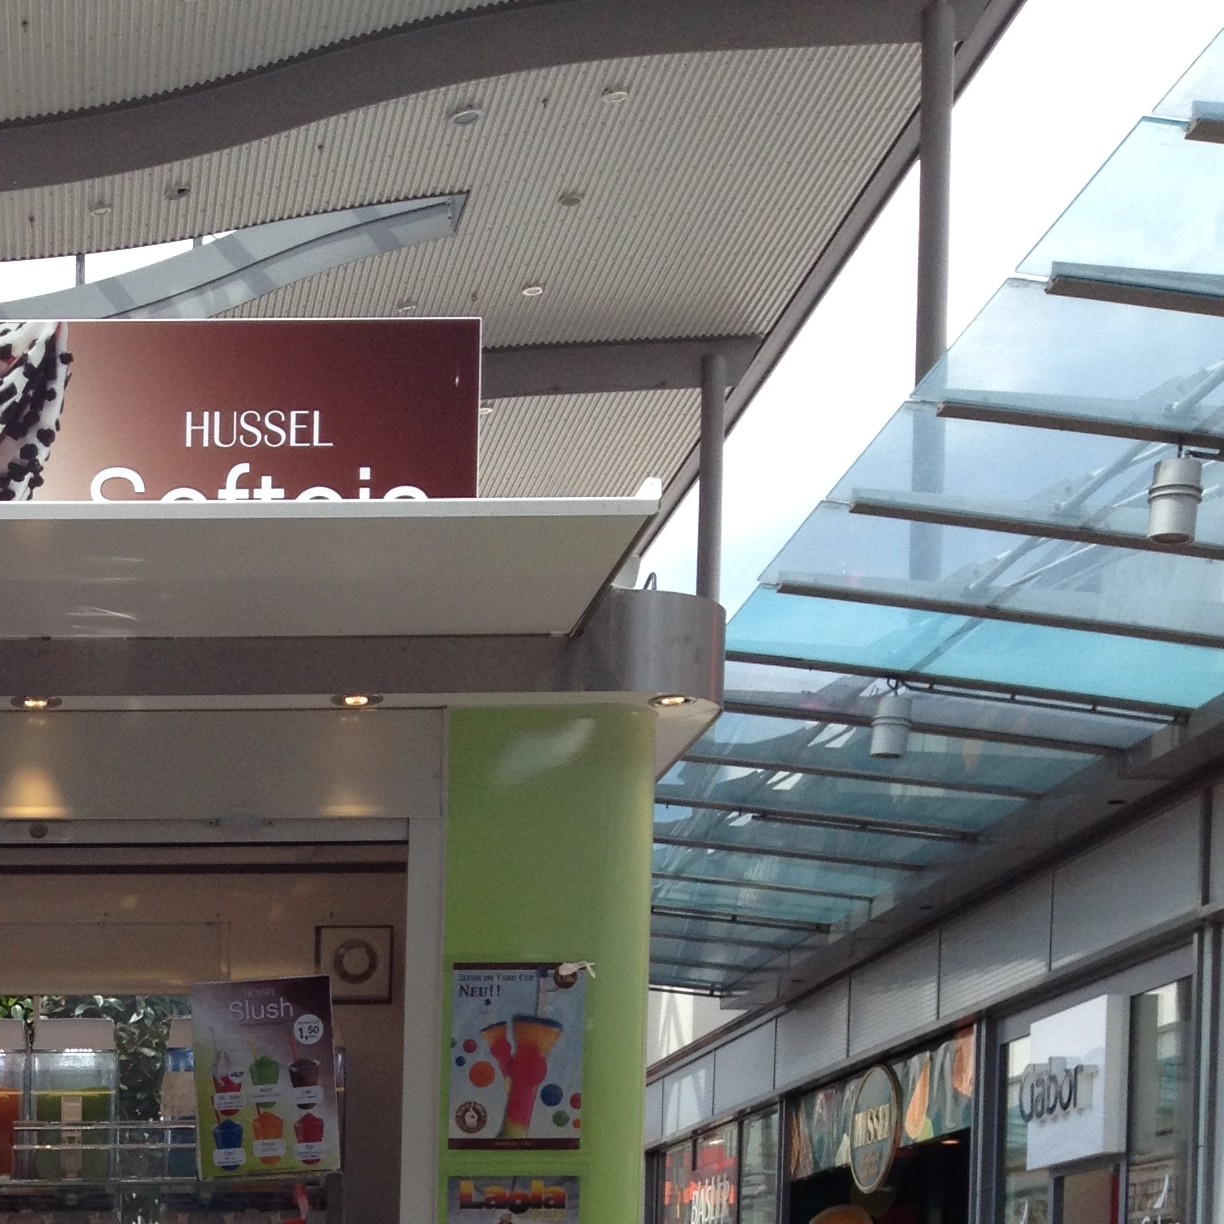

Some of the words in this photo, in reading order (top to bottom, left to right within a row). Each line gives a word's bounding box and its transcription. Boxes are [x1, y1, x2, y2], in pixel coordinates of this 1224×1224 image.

[185, 410, 334, 448] HUSSEL
[229, 997, 294, 1020] Slush
[1019, 1059, 1089, 1122] Gabor
[459, 1180, 567, 1214] Laola
